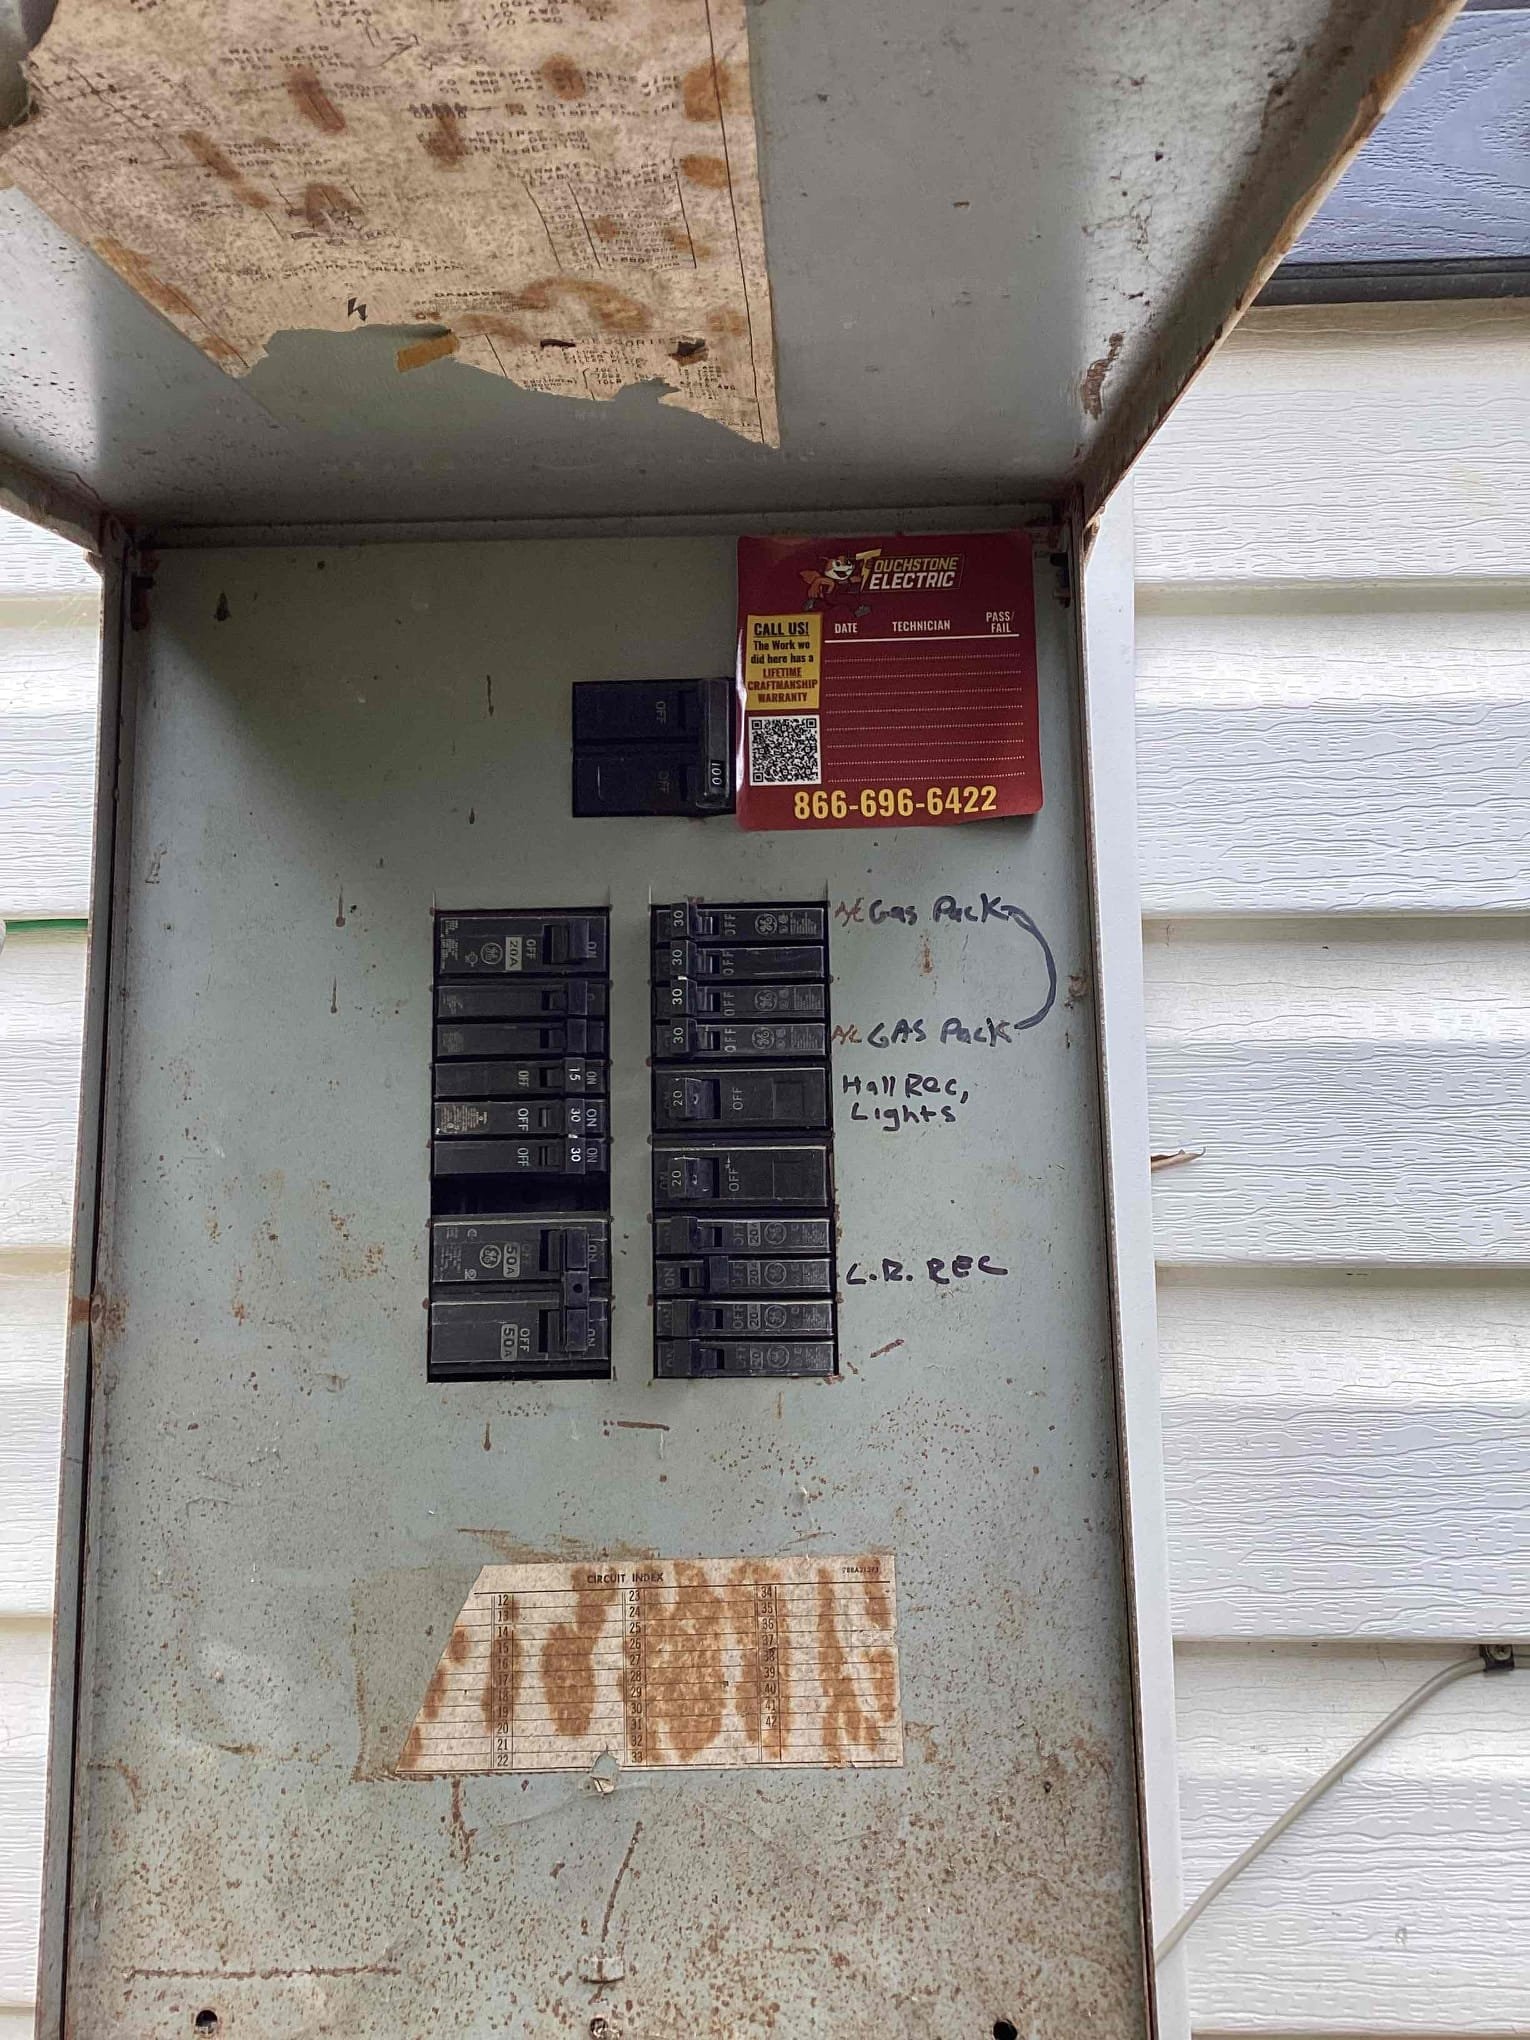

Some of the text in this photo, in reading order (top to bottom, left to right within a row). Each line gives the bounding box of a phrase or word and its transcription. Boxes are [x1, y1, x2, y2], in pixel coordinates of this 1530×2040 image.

[869, 571, 956, 591] ELECTRIC
[754, 621, 809, 635] CALL US!
[834, 620, 951, 634] DATE TECHNICIAN
[991, 622, 1012, 633] FAIL
[753, 640, 810, 651] The Work we
[751, 653, 814, 664] did here has a
[763, 668, 802, 678] LIFETIME
[748, 679, 818, 691] CRAFTMANSHIP
[758, 692, 808, 704] WARRANTY
[712, 763, 722, 785] 100
[794, 786, 998, 820] 866-696-6422
[673, 911, 684, 927] 30
[526, 939, 537, 960] OFF
[587, 941, 598, 959] ON
[672, 950, 683, 966] 30
[723, 951, 735, 976] OFF
[672, 988, 683, 1005] 30
[723, 992, 735, 1016] OFF
[673, 1027, 684, 1044] 30
[868, 1019, 927, 1048] GAS
[724, 1028, 736, 1053] OFF
[518, 1070, 530, 1087] OFF
[568, 1067, 581, 1081] 15
[586, 1071, 597, 1085] ON
[842, 1074, 896, 1097] Hall
[674, 1090, 683, 1106] 20
[732, 1088, 744, 1110] OFF
[518, 1108, 529, 1132] OFF
[570, 1108, 581, 1123] 30
[586, 1109, 597, 1127] ON
[851, 1102, 956, 1132] Lights
[517, 1148, 530, 1167] OFF
[570, 1148, 581, 1162] 30
[586, 1147, 598, 1163] ON
[672, 1170, 682, 1186] 20
[728, 1169, 740, 1192] OFF
[504, 1244, 518, 1275] 50A
[927, 1255, 1009, 1284] REC
[665, 1267, 675, 1287] ON
[503, 1328, 515, 1357] 50A
[519, 1328, 530, 1352] OFF
[587, 1572, 664, 1584] CIRCUIT INDEX
[629, 1591, 641, 1601] 23
[761, 1586, 772, 1597] 34
[498, 1595, 509, 1606] 12
[629, 1607, 641, 1617] 24
[762, 1604, 773, 1614] 35
[498, 1611, 509, 1621] 13
[629, 1623, 641, 1633] 25
[762, 1619, 774, 1629] 36
[498, 1627, 509, 1637] 14
[630, 1639, 641, 1649] 26
[763, 1635, 774, 1645] 37
[498, 1643, 509, 1653] 15
[630, 1655, 641, 1665] 27
[764, 1651, 775, 1661] 38
[498, 1659, 509, 1669] 16
[630, 1671, 641, 1681] 28
[764, 1668, 775, 1678] 39
[630, 1687, 642, 1698] 29
[764, 1683, 776, 1694] 40
[631, 1704, 642, 1714] 30
[765, 1700, 776, 1711] 41
[498, 1707, 509, 1717] 19
[631, 1720, 642, 1730] 31
[766, 1716, 777, 1727] 42
[497, 1723, 509, 1733] 20
[497, 1739, 509, 1750] 21
[631, 1736, 643, 1746] 32
[497, 1755, 509, 1766] 22
[631, 1752, 643, 1762] 33
